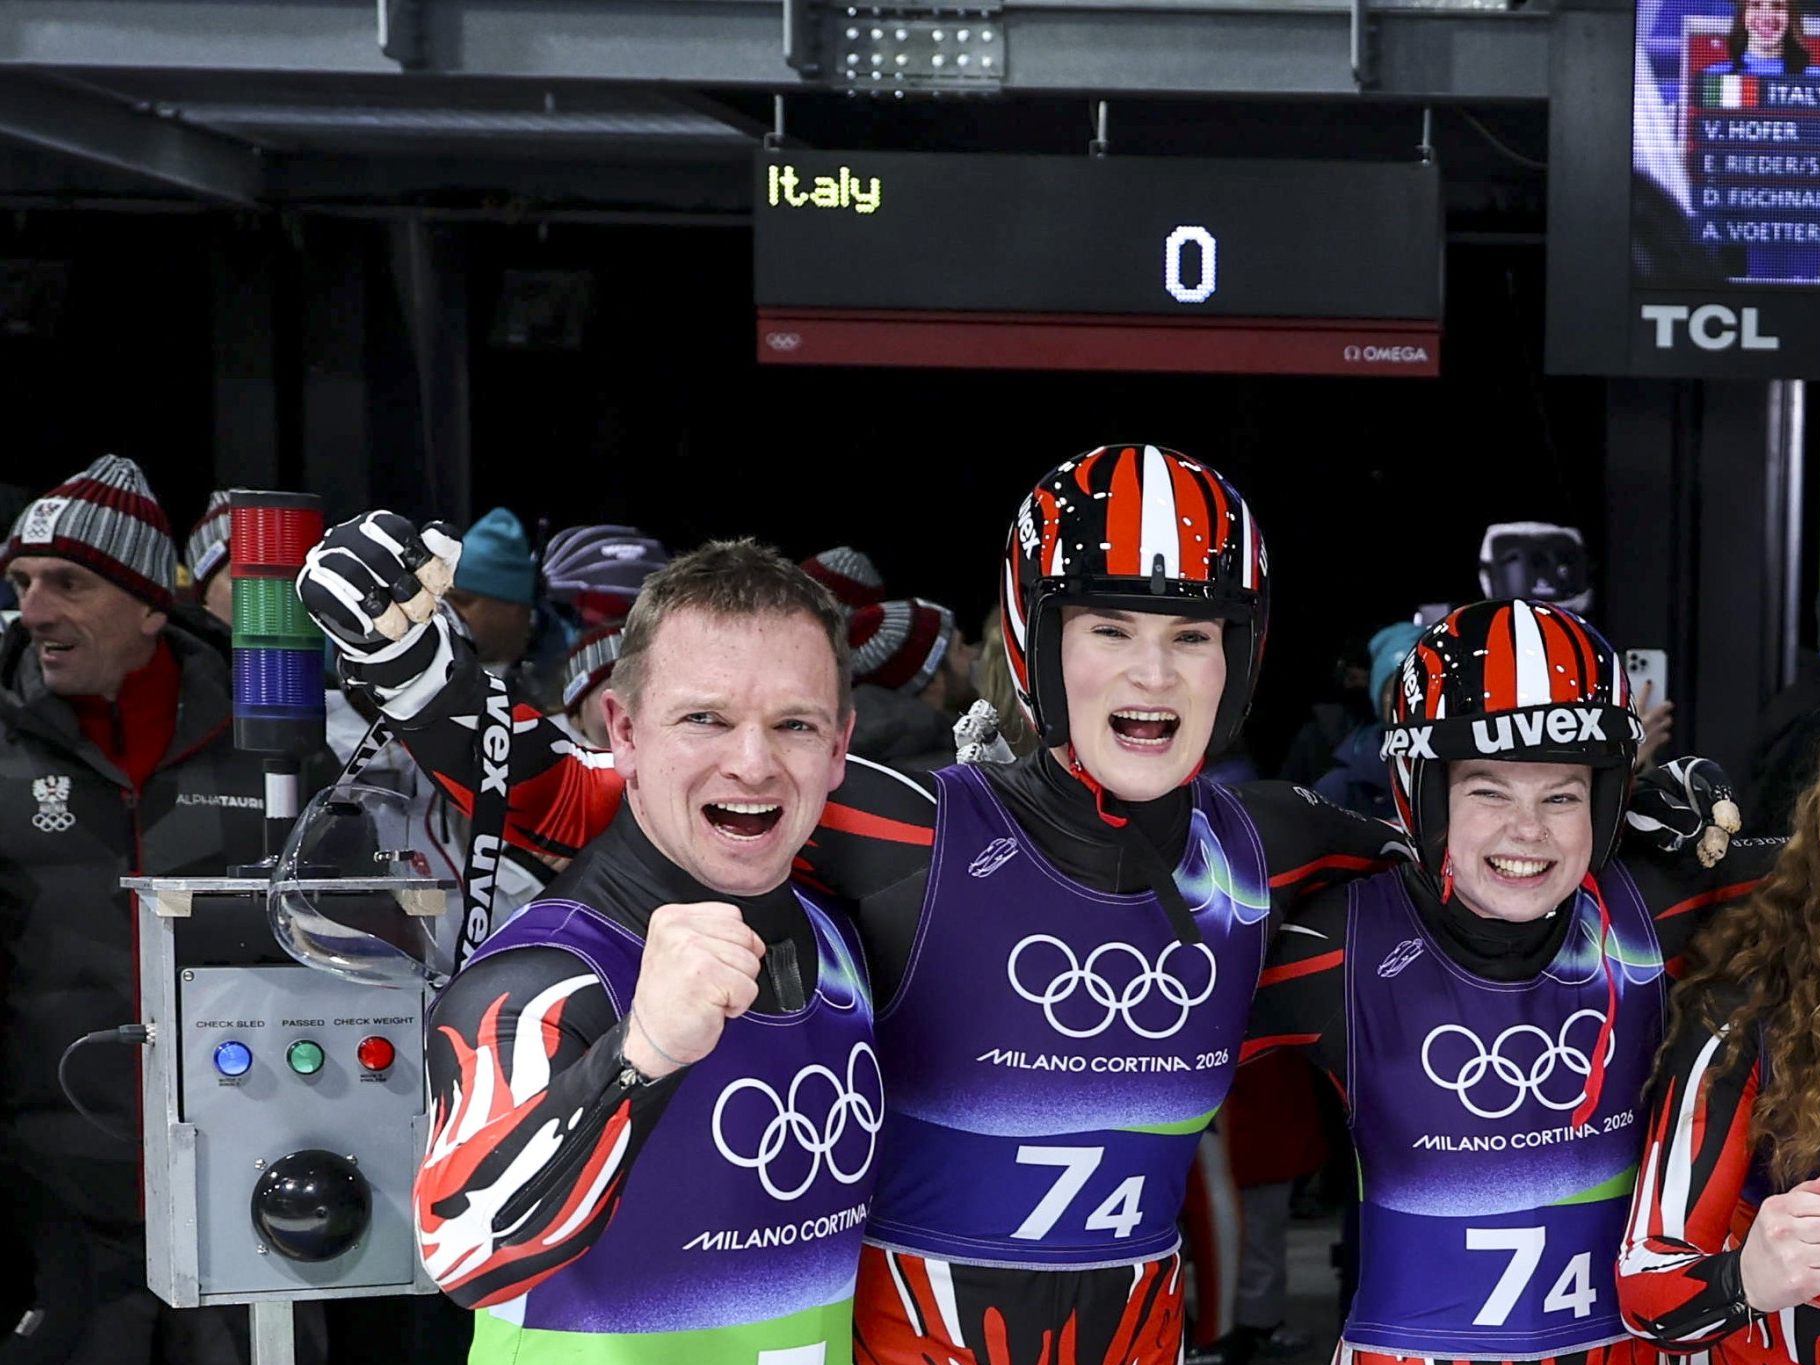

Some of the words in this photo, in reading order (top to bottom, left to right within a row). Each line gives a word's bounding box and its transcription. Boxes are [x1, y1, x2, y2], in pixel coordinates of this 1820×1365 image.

[1728, 121, 1799, 141] HOFER
[768, 165, 881, 213] Italy
[1164, 225, 1218, 303] 0
[1641, 305, 1780, 350] TCL
[1362, 346, 1429, 361] OMEGA
[1472, 707, 1607, 755] uvex
[195, 1020, 232, 1029] CHECK
[236, 1020, 265, 1028] SLED
[281, 1019, 325, 1027] PASSED
[333, 1018, 370, 1026] CHECK
[373, 1016, 415, 1025] WEIGHT
[975, 1048, 1086, 1073] MILANO
[1091, 1056, 1191, 1074] CORTINA
[1196, 1048, 1229, 1071] 2026
[1412, 1133, 1507, 1152] MILANO
[1511, 1123, 1600, 1150] CORTINA
[1603, 1108, 1635, 1134] 2026
[682, 1224, 797, 1252] MILANO
[800, 1202, 867, 1242] CORTINA
